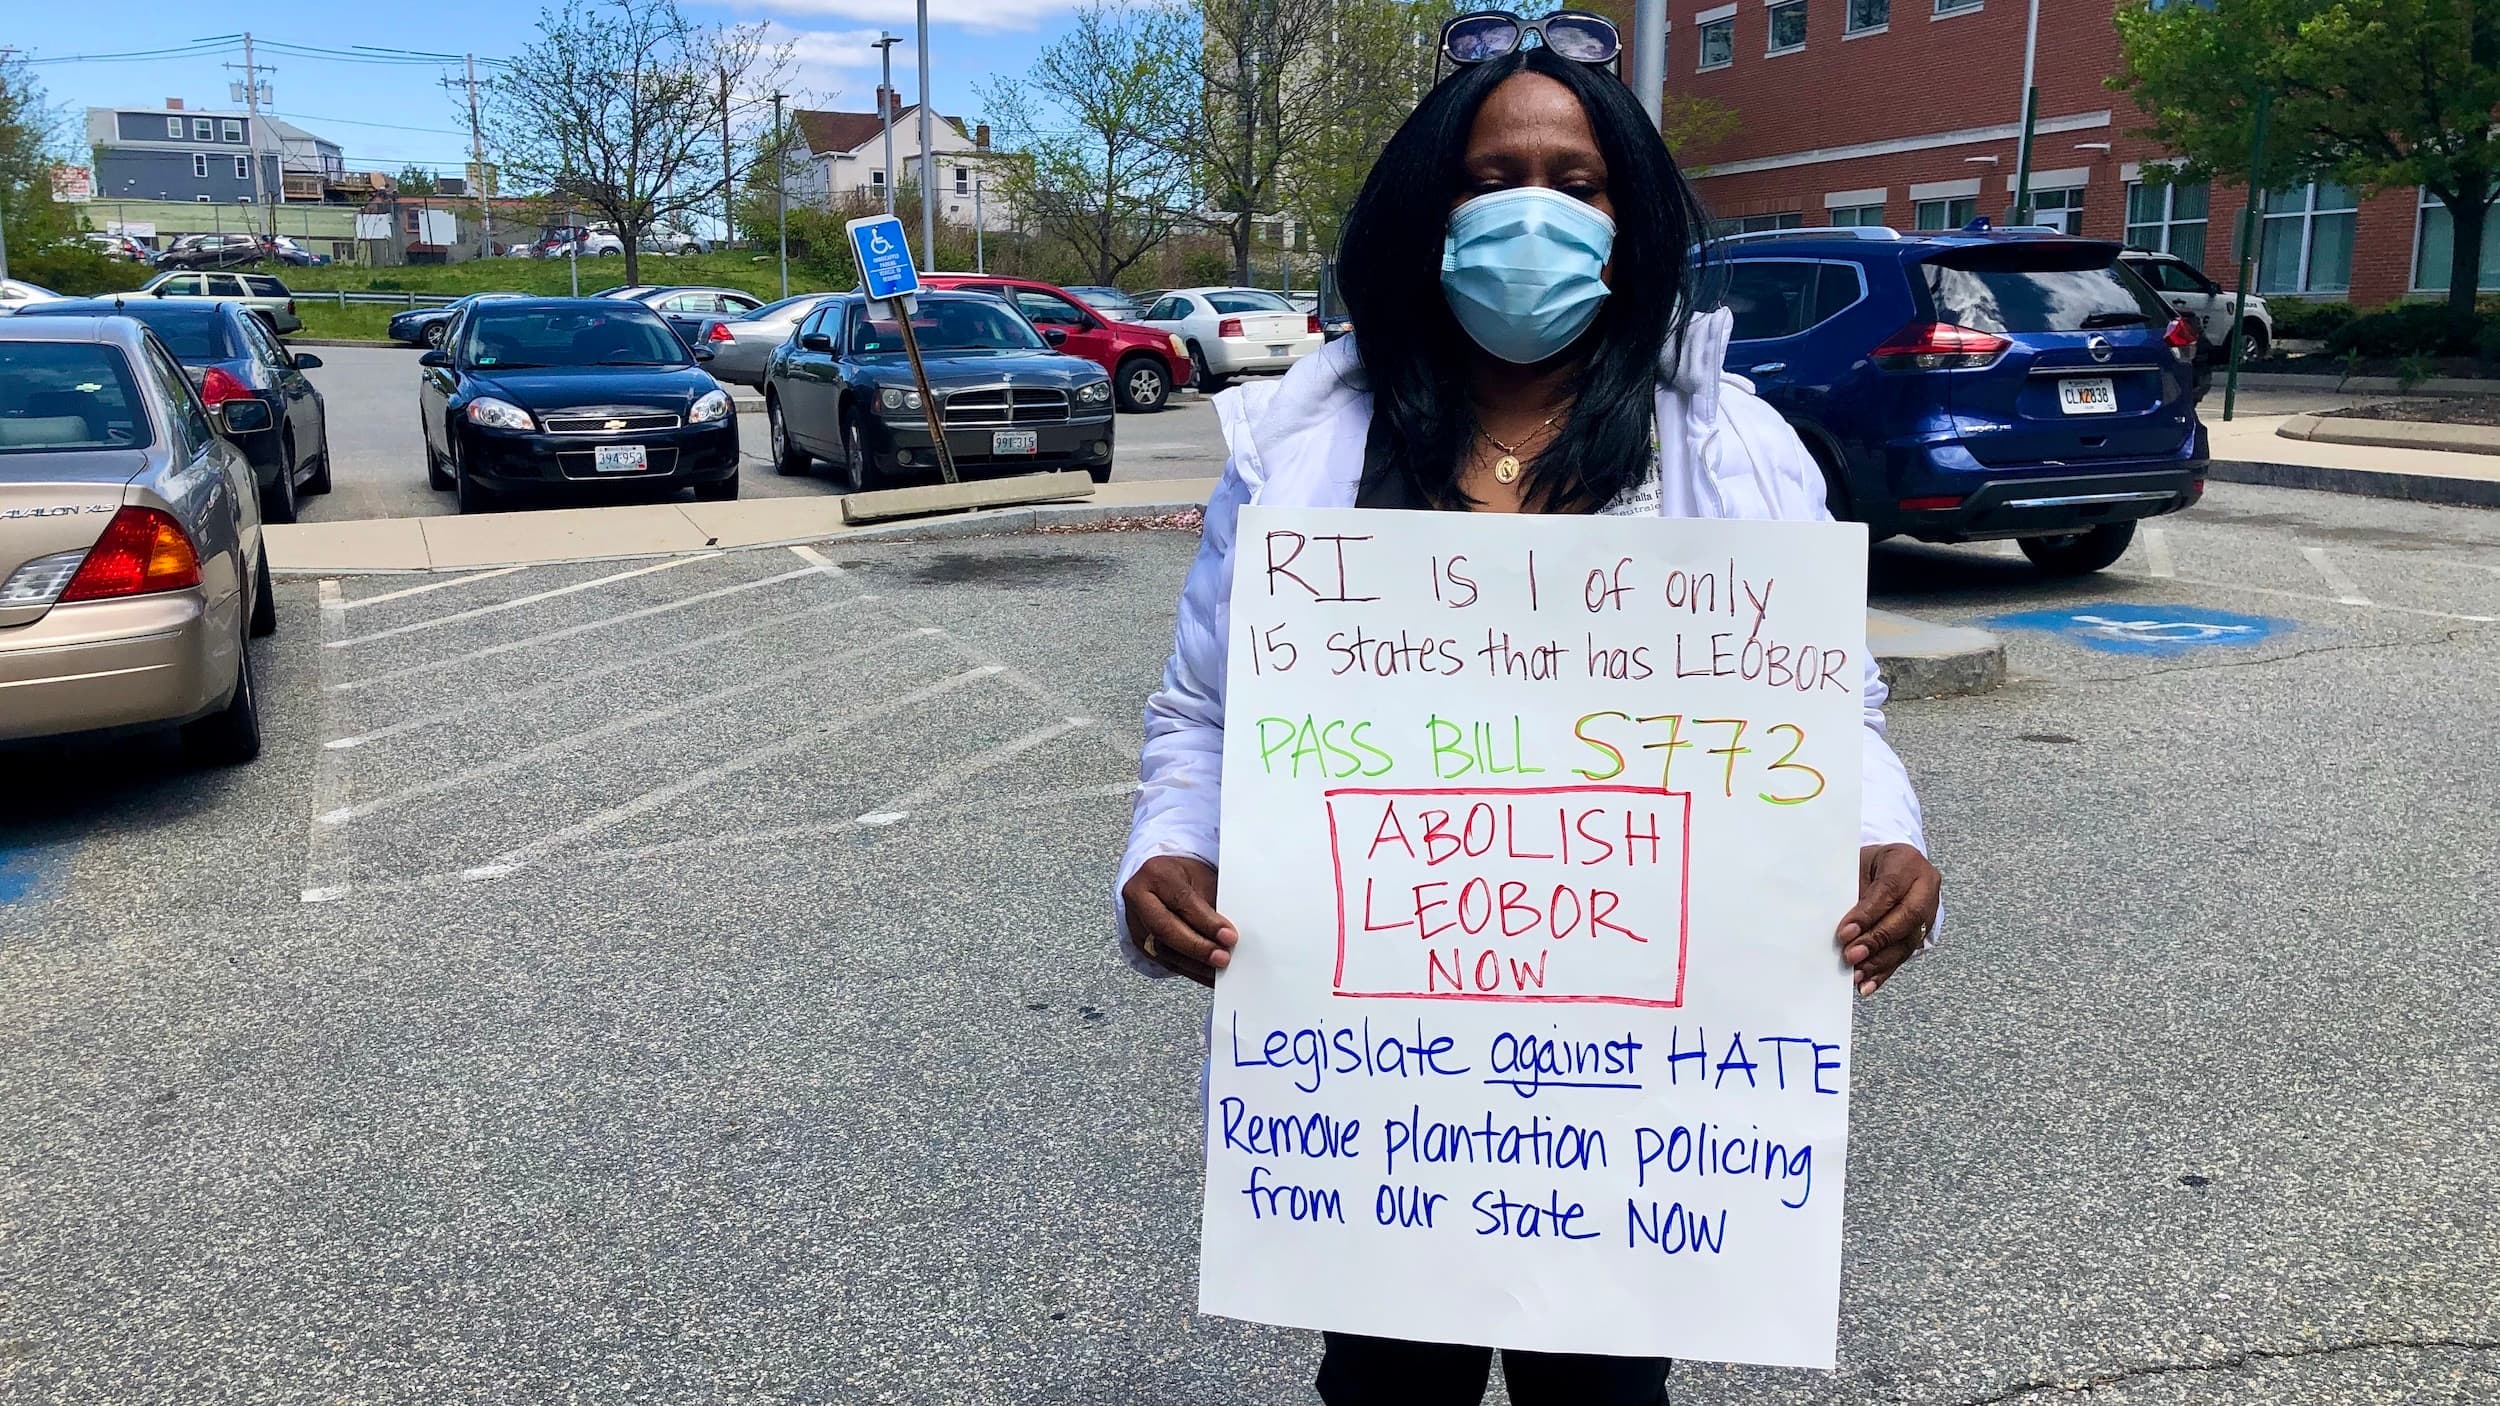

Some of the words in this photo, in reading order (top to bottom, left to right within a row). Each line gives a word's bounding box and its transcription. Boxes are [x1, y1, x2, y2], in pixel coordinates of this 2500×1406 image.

[0, 504, 80, 519] AVALON
[84, 503, 115, 513] XLS
[1266, 530, 1381, 603] RI
[1585, 557, 1635, 612] of
[1666, 557, 1774, 637] only
[1251, 622, 1297, 673] 15
[1478, 629, 1570, 681] that
[1587, 633, 1653, 680] has
[1676, 632, 1850, 693] LEOBOR
[1256, 714, 1393, 778] PASS
[1426, 714, 1545, 778] BILL
[1572, 711, 1825, 804] S773
[1367, 799, 1660, 865] ABOLISH
[1364, 877, 1648, 942] LEOBOR
[1429, 948, 1547, 992] NOW
[1233, 1012, 1470, 1092] Legislate
[1489, 1023, 1642, 1098] against
[1667, 1024, 1842, 1095] HATE
[1219, 1096, 1360, 1160] Remove
[1385, 1104, 1608, 1175] plantation
[1635, 1123, 1813, 1209] policing
[1241, 1165, 1345, 1225] from
[1375, 1184, 1450, 1230] our
[1628, 1197, 1727, 1255] NOW
